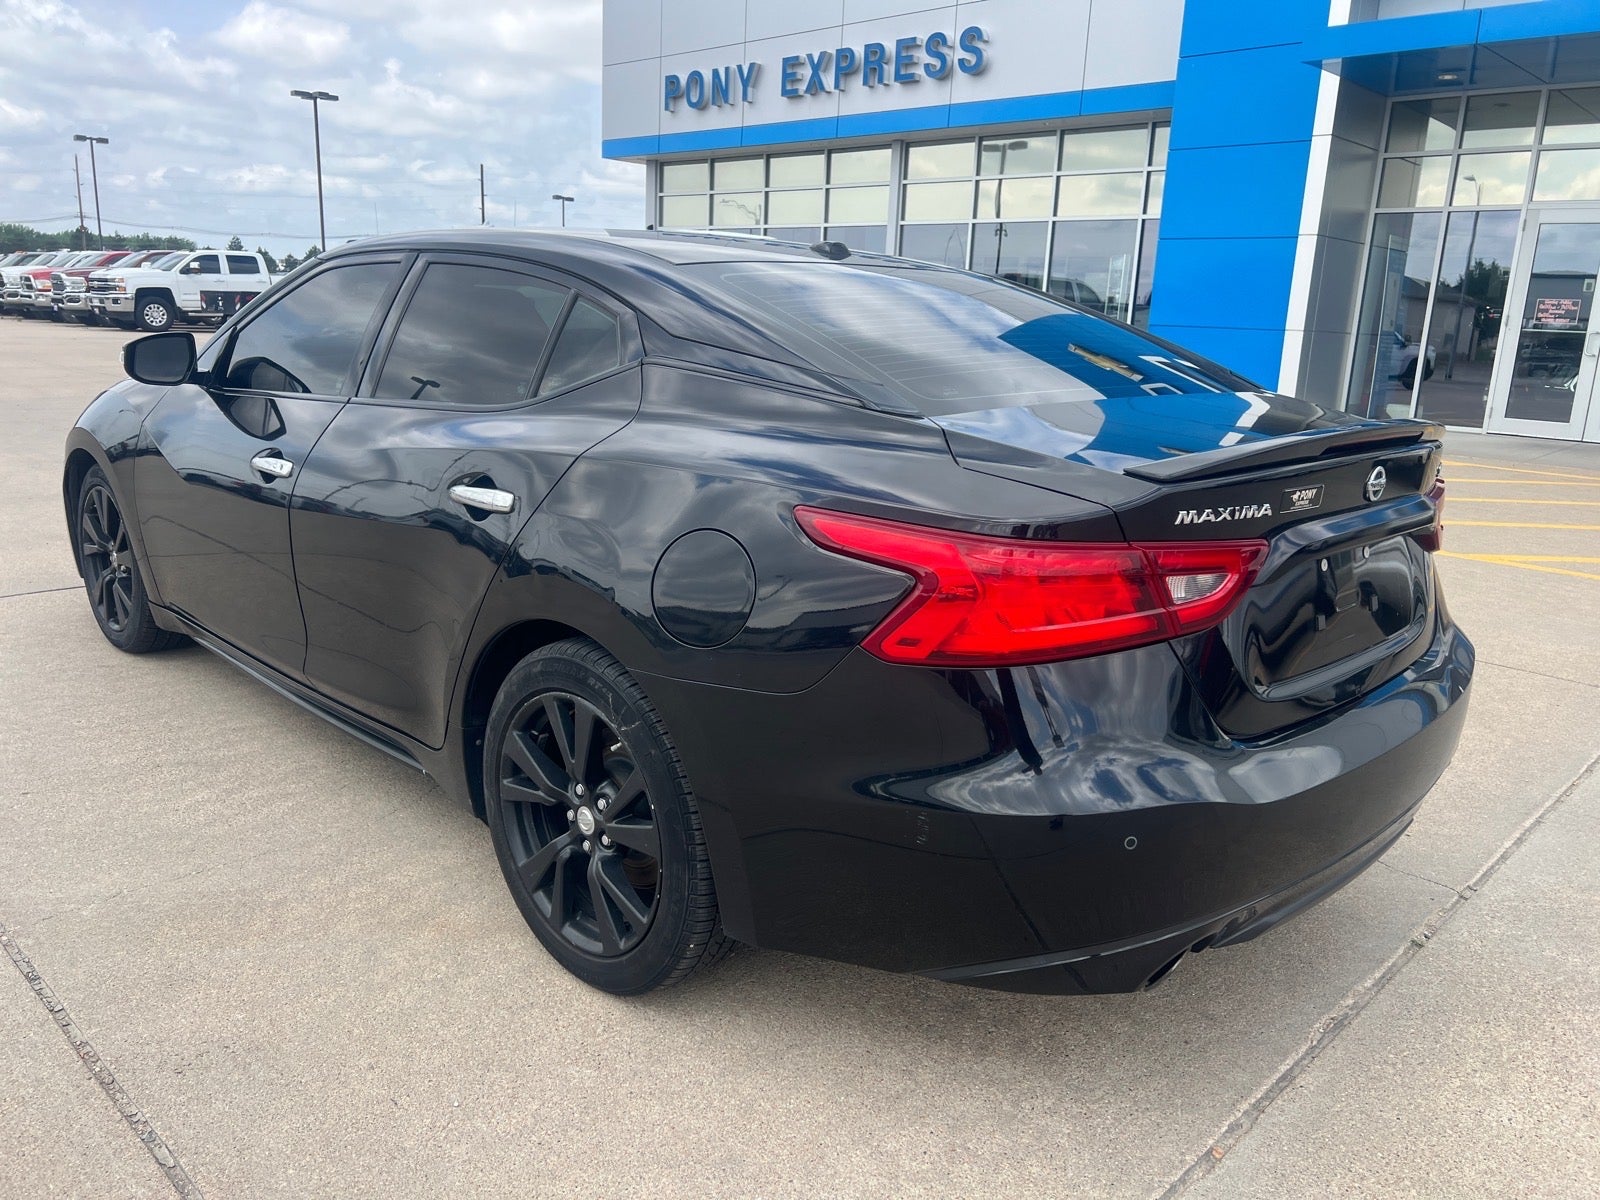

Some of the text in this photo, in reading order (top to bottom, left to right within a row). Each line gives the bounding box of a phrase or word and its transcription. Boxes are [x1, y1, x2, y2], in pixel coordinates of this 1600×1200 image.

[664, 25, 989, 112] PONY EXPRESS
[1300, 488, 1318, 500] PONY
[1174, 503, 1272, 525] MAXIMA
